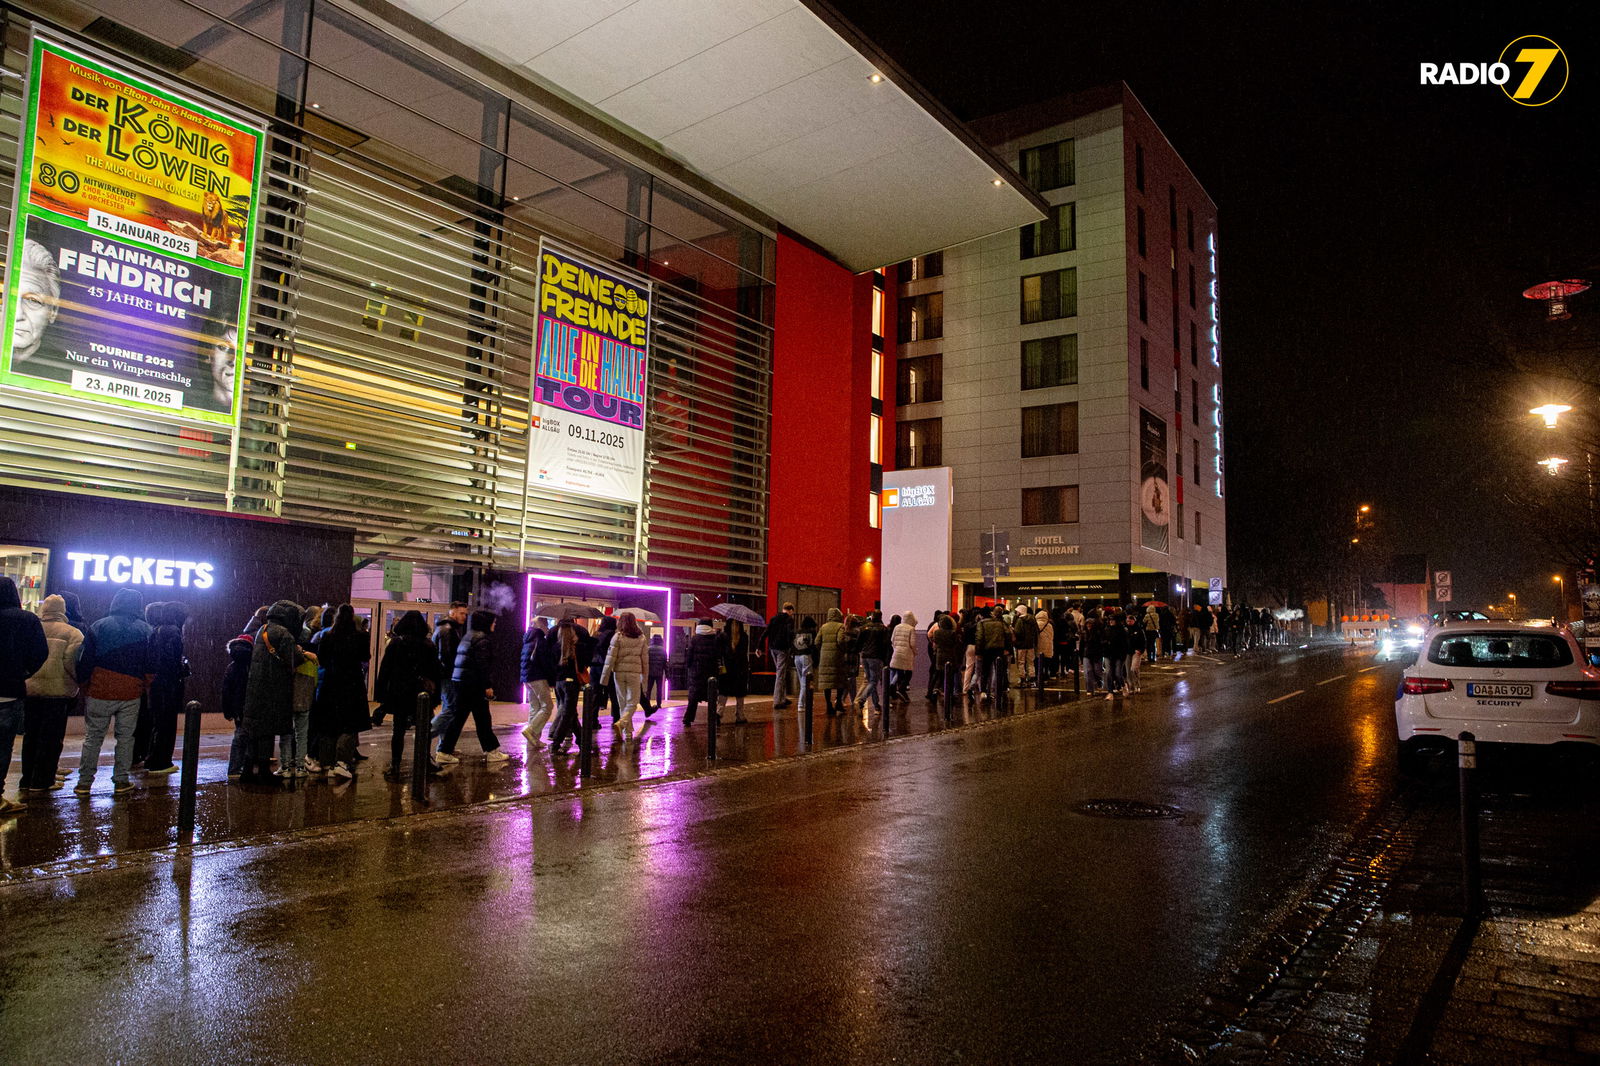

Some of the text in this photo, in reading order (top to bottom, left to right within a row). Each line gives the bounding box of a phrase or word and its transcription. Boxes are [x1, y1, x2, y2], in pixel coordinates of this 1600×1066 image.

[69, 64, 235, 137] Musik von Elton John & Hans Zimmer
[71, 86, 230, 168] DER KÖNIG
[63, 117, 230, 198] DER LÖWEN
[38, 162, 80, 194] 80
[83, 185, 101, 196] CHOR
[106, 192, 136, 207] SOLISTEN
[85, 154, 200, 201] THE MUSIC LIVE IN CONCERT
[88, 194, 125, 210] ORCHESTER
[97, 215, 190, 253] 15. JANUAR 2025
[91, 240, 190, 278] RAINHARD
[58, 248, 212, 309] FENDRICH
[542, 254, 614, 306] DEINE
[87, 286, 186, 319] 45 JAHRE LIVE
[541, 283, 646, 345] FREUNDE
[65, 350, 192, 387] Nur ein Wimpernschlag
[89, 342, 174, 369] TOURNEE 2025
[538, 318, 645, 403] ALLE IN DIE HALLE
[86, 378, 171, 404] 23. APRIL 2025
[536, 376, 642, 426] TOUR
[568, 424, 624, 449] 09.11.2025
[1020, 545, 1080, 556] RESTAURANT
[1034, 536, 1064, 545] HOTEL
[67, 552, 214, 589] TICKETS
[1474, 685, 1530, 696] OA AG 902
